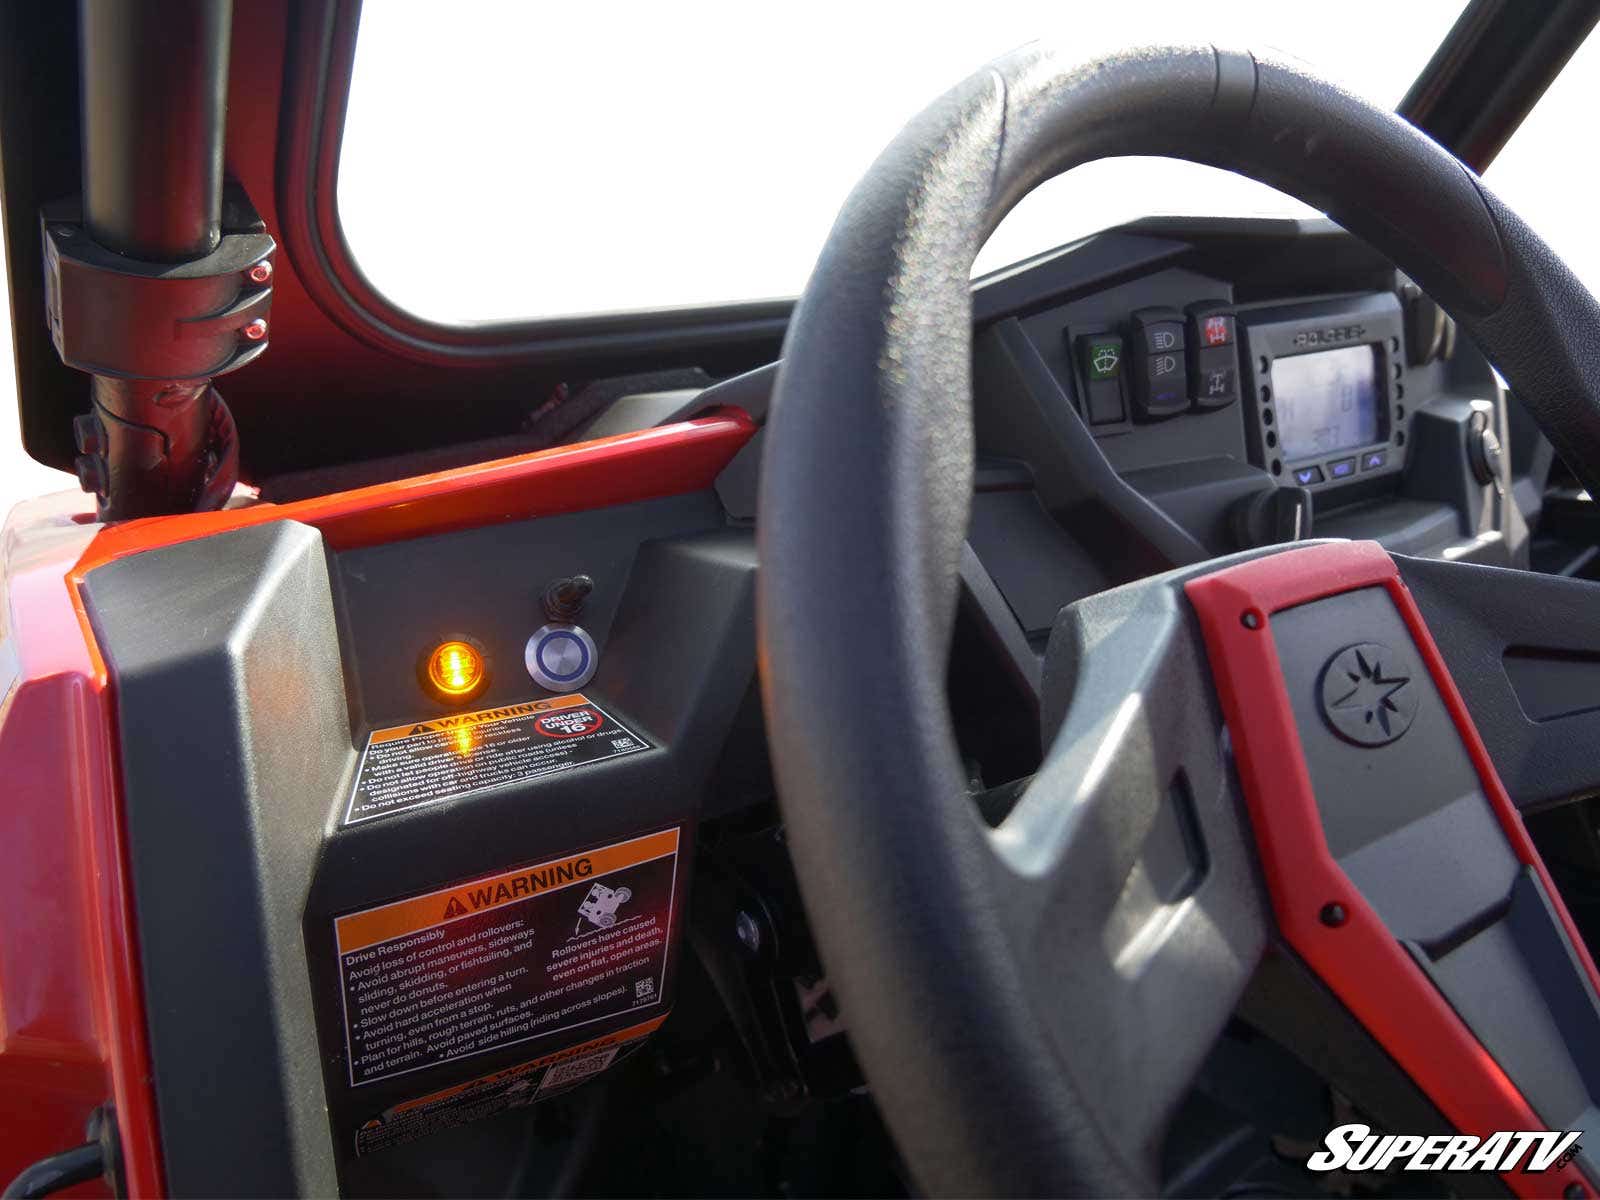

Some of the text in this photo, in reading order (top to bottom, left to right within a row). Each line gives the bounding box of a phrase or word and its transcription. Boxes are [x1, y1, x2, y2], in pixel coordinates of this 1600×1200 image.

[370, 738, 410, 749] Require
[411, 731, 447, 741] Proper
[500, 714, 535, 724] Vehicle
[438, 701, 552, 728] WARNING
[539, 710, 590, 723] DRIVER
[544, 715, 594, 729] UNDER
[559, 723, 588, 734] 16
[366, 782, 381, 791] Do
[382, 779, 398, 787] not
[400, 773, 425, 783] allow
[427, 764, 473, 778] operation
[487, 755, 517, 765] public
[516, 749, 544, 758] roads
[544, 742, 578, 753] (unless
[367, 776, 382, 784] Do
[415, 763, 448, 774] people
[449, 758, 473, 766] drive
[504, 747, 525, 755] after
[526, 742, 552, 751] using
[551, 735, 586, 745] alcohol
[370, 762, 398, 771] Make
[421, 748, 468, 762] operato
[373, 768, 394, 776] with
[403, 761, 426, 770] valid
[378, 752, 414, 765] driving.
[383, 744, 405, 753] your
[406, 740, 425, 748] part
[408, 744, 432, 752] allow
[361, 802, 377, 811] Do
[378, 798, 394, 806] not
[396, 790, 433, 803] exceed
[434, 782, 471, 795] seating
[471, 772, 516, 787] capacity:
[368, 779, 426, 797] designated
[441, 765, 497, 781] off-highway
[498, 758, 531, 768] vehicle
[532, 750, 569, 761] access)
[371, 787, 418, 802] collisions
[420, 782, 441, 791] with
[479, 768, 509, 778] trucks
[469, 855, 593, 911] WARNING
[345, 927, 444, 966] Drive Responsibly
[349, 917, 524, 980] Avoid loss of control and rollovers:
[357, 926, 534, 990] Avoid abrupt maneuvers, sideways
[546, 924, 663, 972] severe injuries and death,
[551, 916, 655, 959] Rollovers have caused
[552, 936, 662, 982] even on flat, open areas.
[358, 938, 531, 1005] sliding, skidding, or fishtailing, and
[360, 964, 528, 1028] Slow down before entering a turn.
[360, 979, 447, 1015] never do donuts.
[361, 1048, 385, 1064] Plan
[386, 1043, 401, 1055] for
[402, 1034, 427, 1051] hills,
[428, 1023, 457, 1043] rough
[496, 1002, 517, 1018] ruts,
[520, 995, 537, 1009] and
[539, 985, 563, 1002] other
[565, 971, 604, 993] changes
[606, 968, 613, 977] in
[615, 955, 649, 974] traction
[363, 981, 511, 1040] Avoid hard acceleration when
[363, 1061, 383, 1075] and
[426, 1035, 455, 1054] Avoid
[456, 1024, 487, 1044] paved
[489, 1007, 533, 1031] surfaces.
[365, 999, 493, 1053] turning, even from a stop.
[446, 1039, 474, 1057] Avoid
[478, 1031, 498, 1046] side
[499, 1019, 528, 1040] hilling
[530, 1008, 559, 1028] (riding
[560, 998, 591, 1016] across
